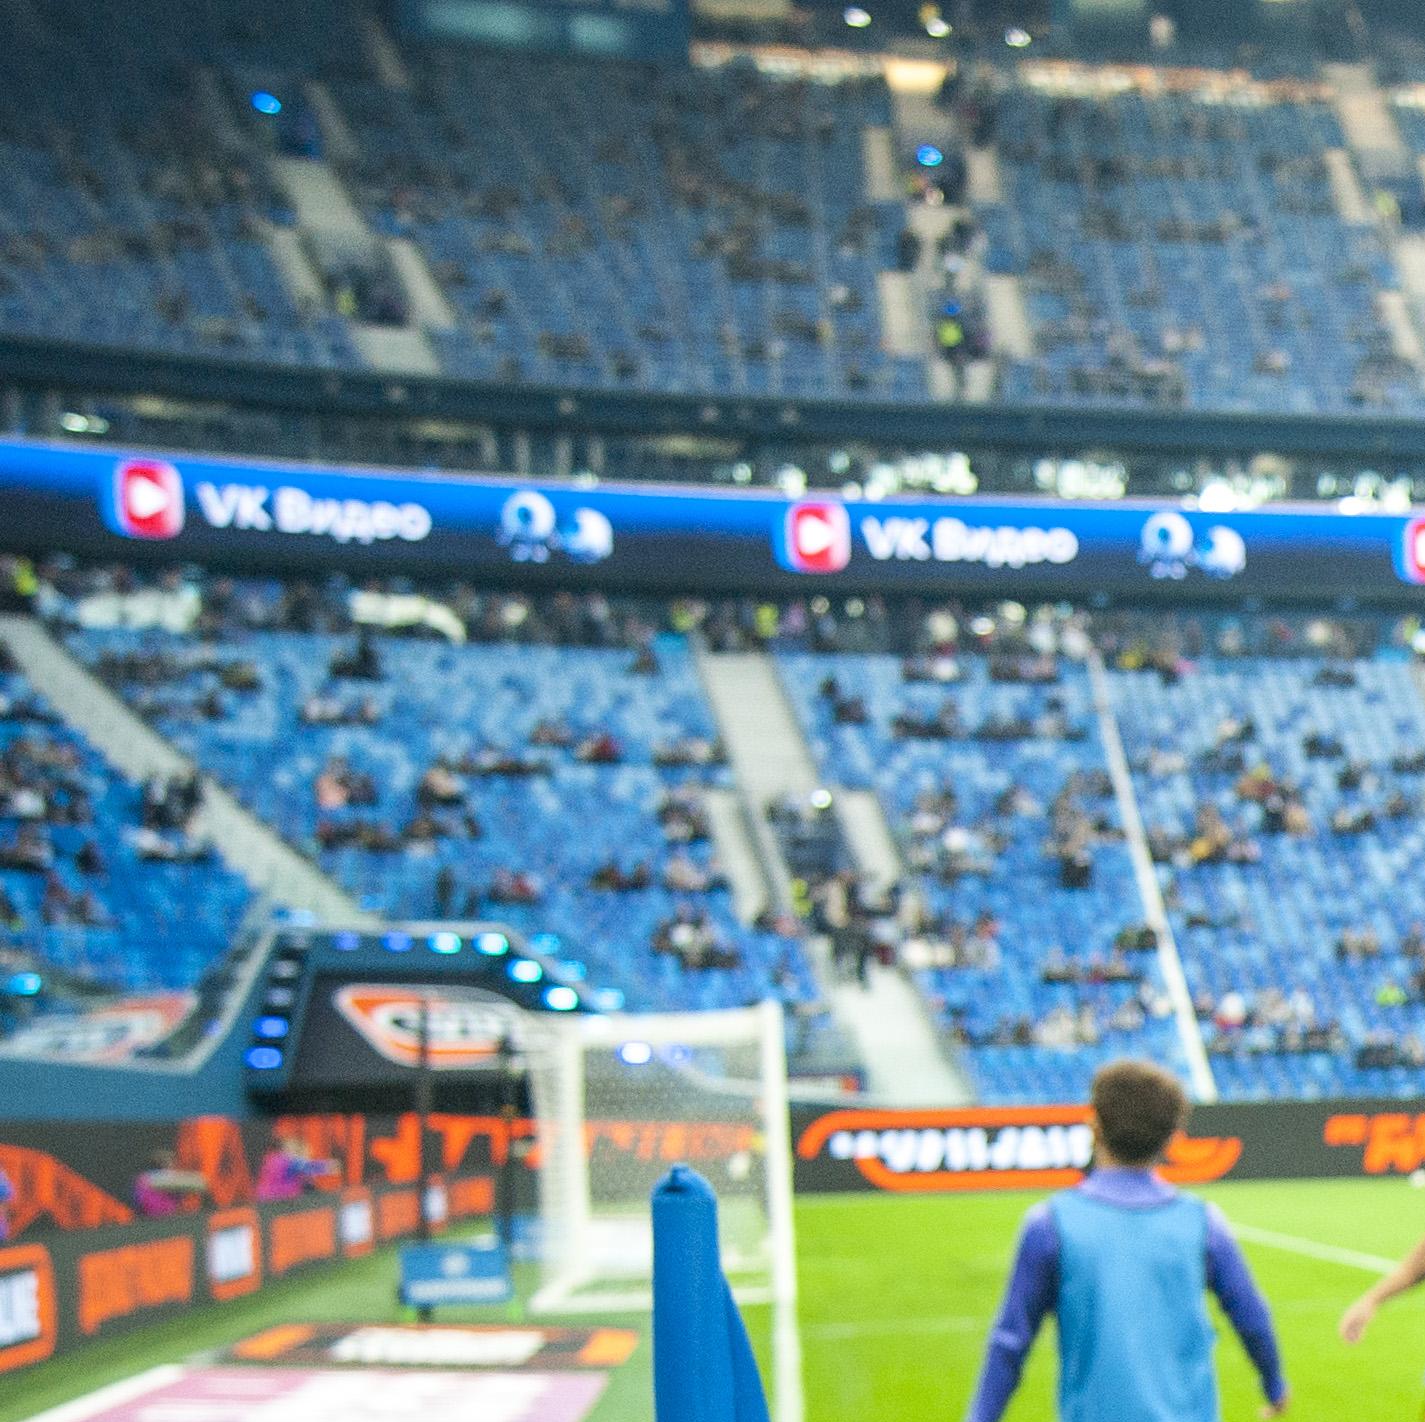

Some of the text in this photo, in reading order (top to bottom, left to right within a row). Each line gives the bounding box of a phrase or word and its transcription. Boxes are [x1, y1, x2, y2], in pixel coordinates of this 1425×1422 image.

[195, 481, 432, 545] VK Видео
[861, 515, 1079, 569] VK Видео
